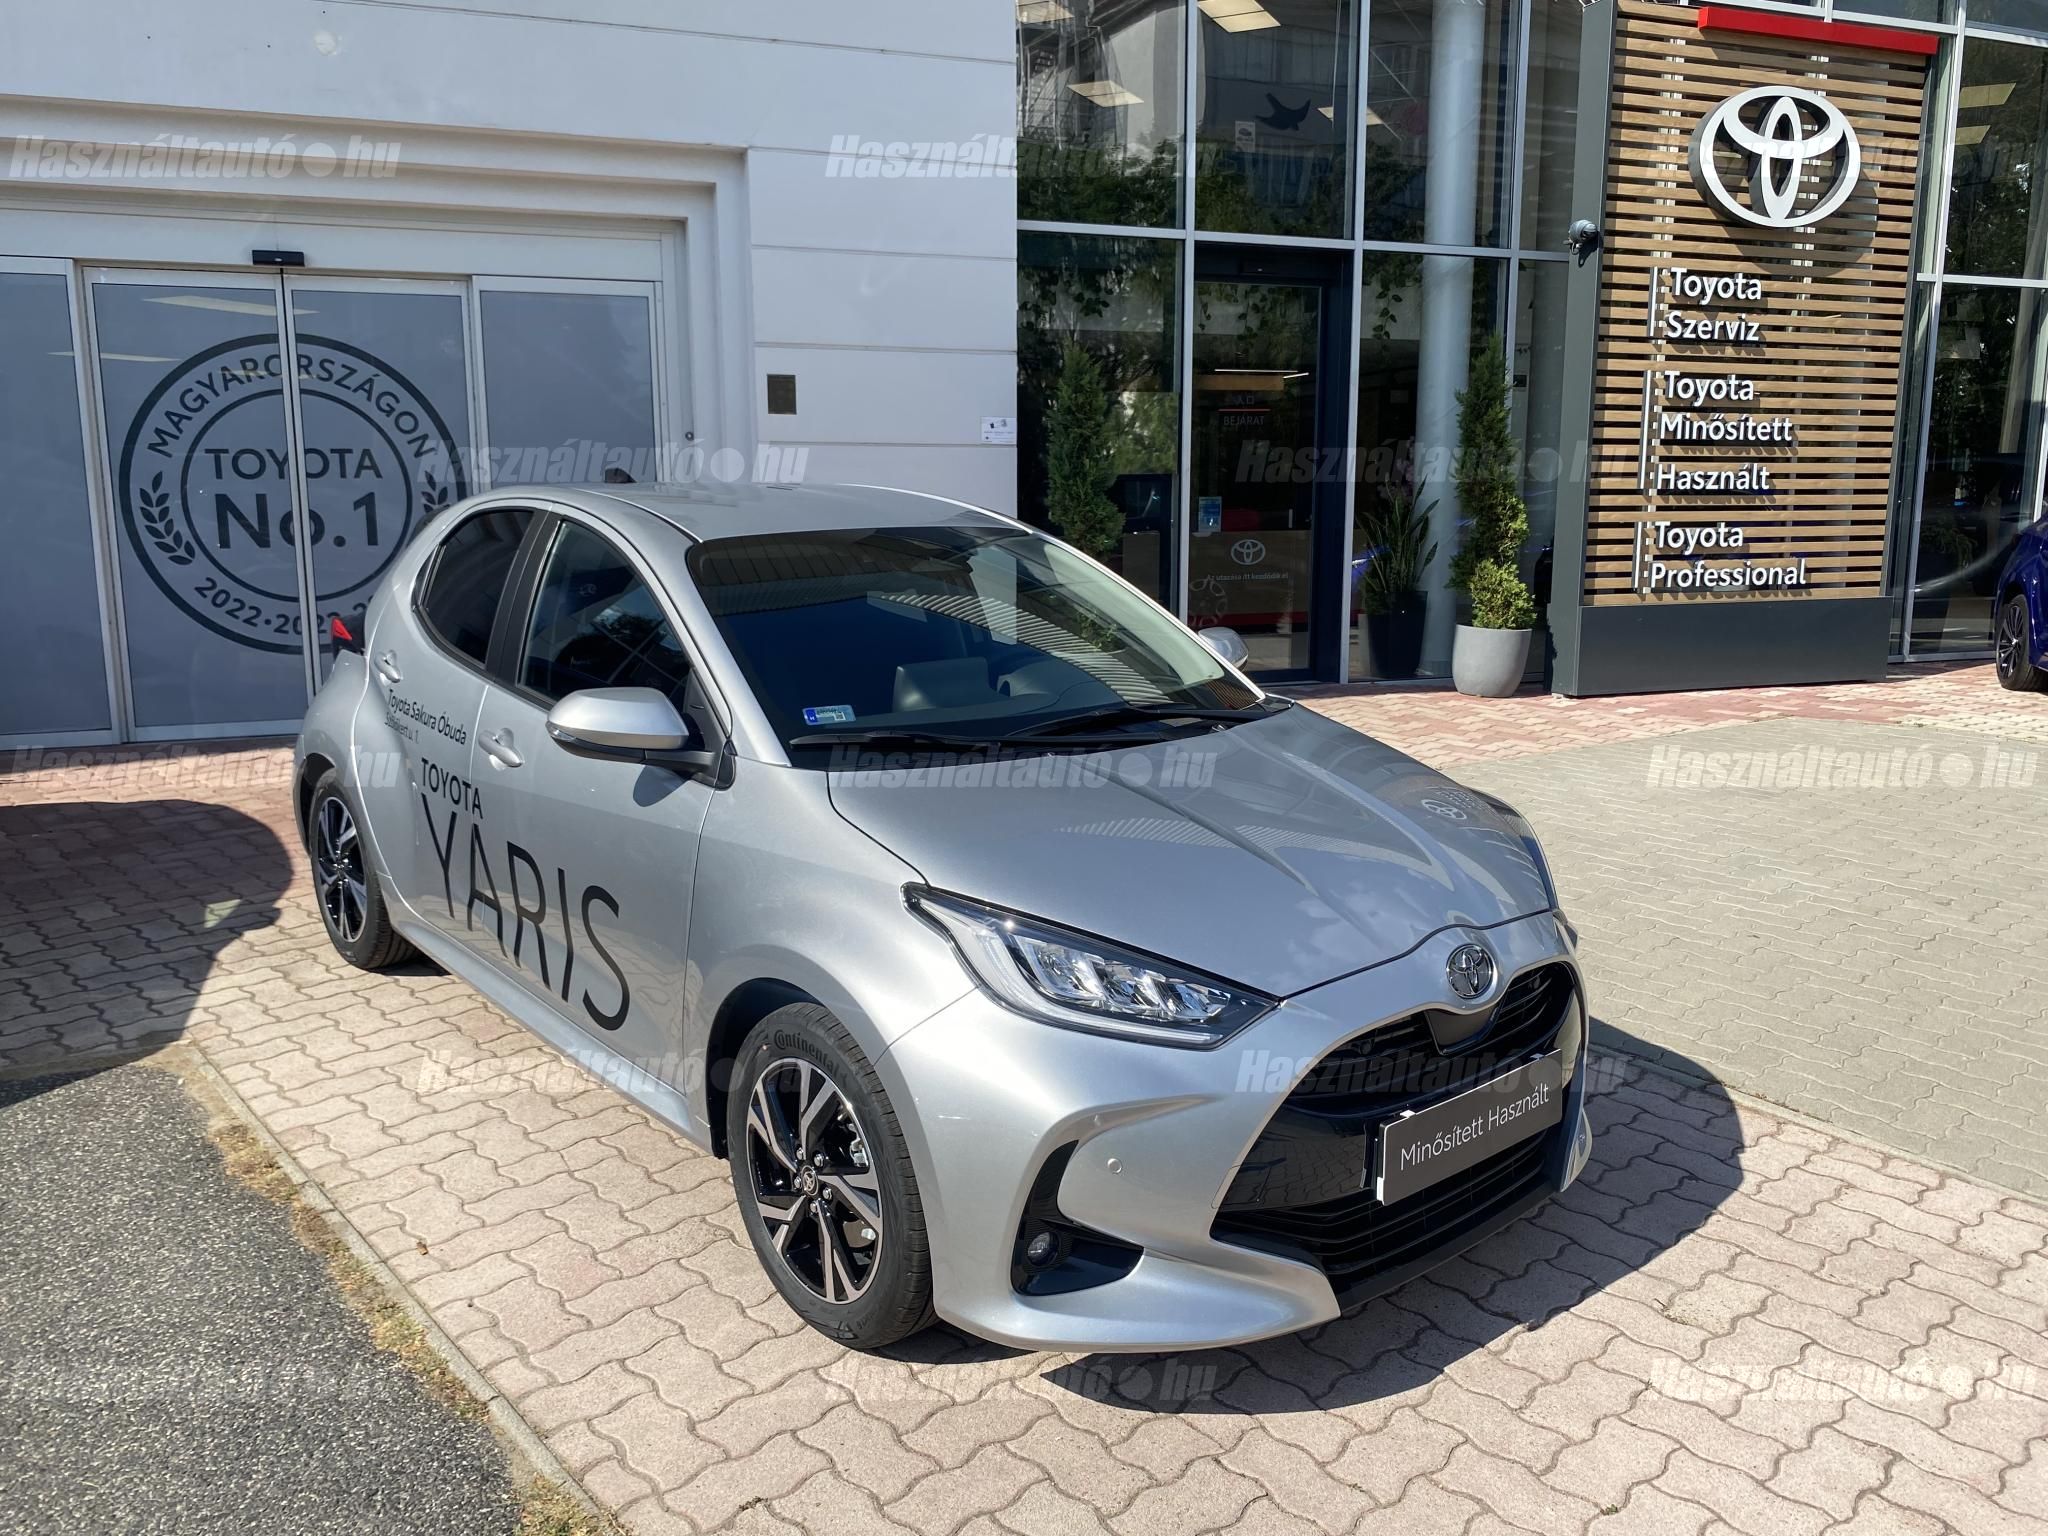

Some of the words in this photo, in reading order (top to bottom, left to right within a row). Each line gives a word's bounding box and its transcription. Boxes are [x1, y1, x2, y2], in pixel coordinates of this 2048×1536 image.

[1670, 267, 1762, 305] Toyota
[1666, 310, 1760, 342] Szerviz
[148, 353, 437, 459] MAGYARORSZÁGON
[1664, 370, 1755, 406] Toyota
[1659, 413, 1793, 442] Minősített
[205, 447, 383, 480] TOYOTA
[1655, 463, 1770, 491] Használt
[1654, 520, 1745, 555] Toyota
[1650, 559, 1807, 589] Professional
[387, 688, 411, 715] Toyota
[410, 701, 437, 730] Sakura
[437, 710, 467, 746] Óbuda
[421, 757, 484, 820] TOYOTA
[421, 793, 631, 1031] YARIS
[774, 1029, 840, 1079] Continental
[1400, 1119, 1484, 1171] Minősített
[1487, 1083, 1550, 1131] Használt
